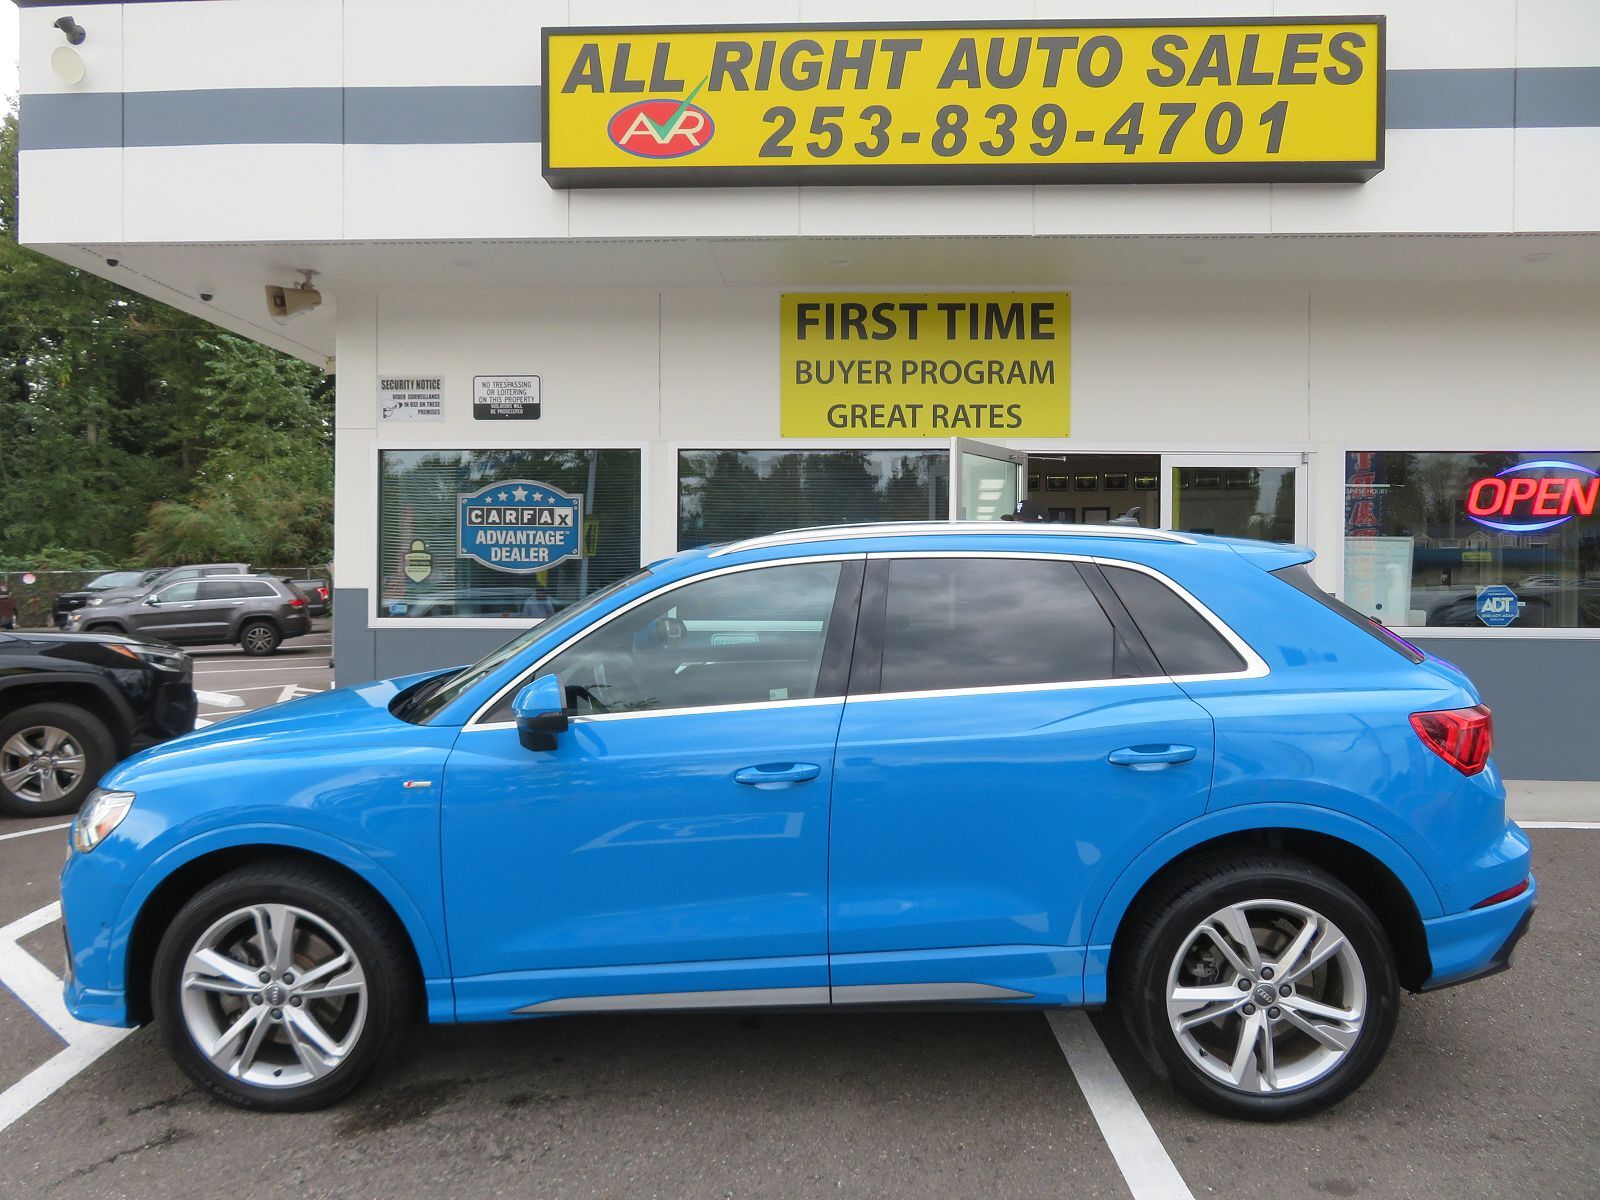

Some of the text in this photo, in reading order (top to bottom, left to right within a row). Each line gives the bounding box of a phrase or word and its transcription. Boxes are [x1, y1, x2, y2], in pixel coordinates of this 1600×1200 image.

[561, 32, 1367, 93] ALL RIGHT AUTO SALES
[758, 101, 1289, 157] 253-839-4701
[796, 303, 1055, 340] FIRST TIME
[796, 360, 1055, 384] BUYER PROGRAM
[381, 379, 440, 390] SECURITY NOTICE
[493, 381, 532, 389] TRESPASSING
[827, 404, 1022, 428] GREAT RATES
[1466, 477, 1600, 516] OPEN
[470, 510, 569, 525] CARFAX
[475, 530, 565, 545] ADVANTAGE
[491, 547, 549, 561] DEALER
[1481, 597, 1514, 613] ADT
